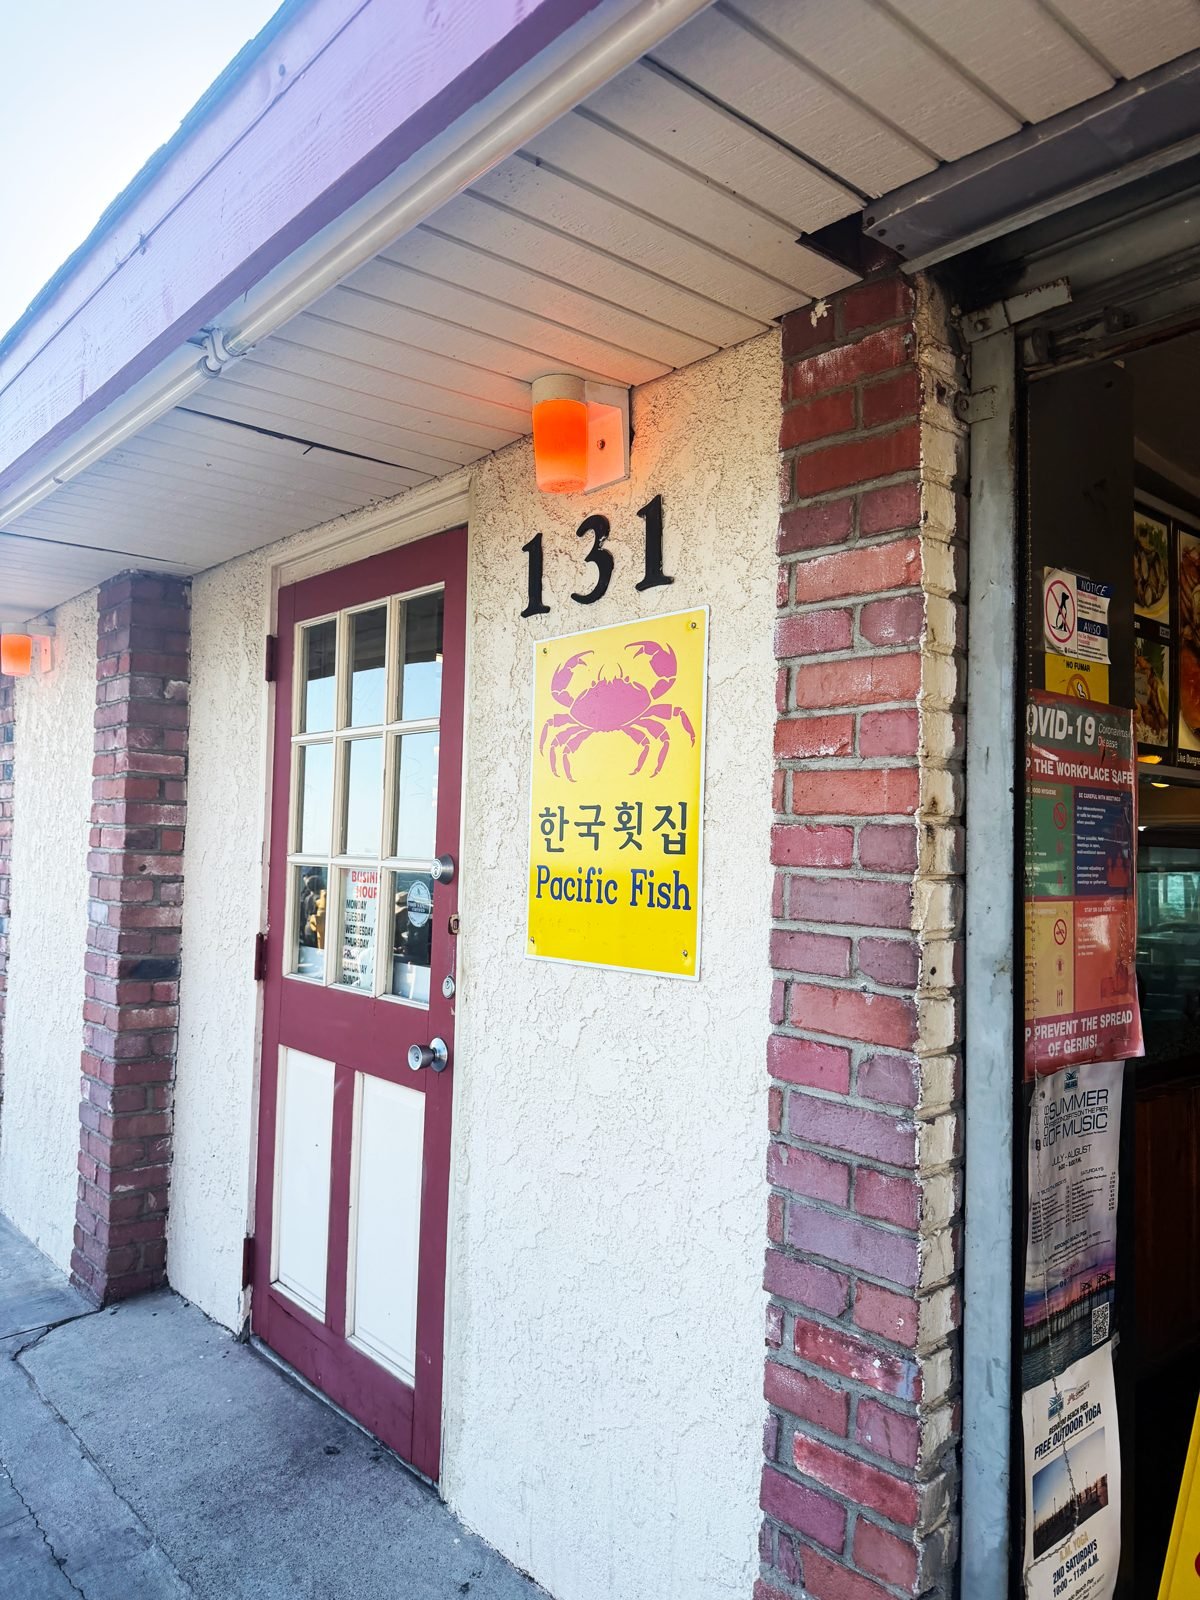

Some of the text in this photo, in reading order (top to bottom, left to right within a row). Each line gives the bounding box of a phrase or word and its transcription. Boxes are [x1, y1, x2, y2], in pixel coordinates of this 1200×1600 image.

[520, 494, 674, 619] 131
[1080, 580, 1108, 596] NOTICE
[1083, 622, 1102, 635] AVISO
[1066, 661, 1090, 673] NO FUMAR
[1026, 703, 1096, 746] OVID-19
[1034, 758, 1054, 775] THE
[1056, 763, 1110, 782] WORKPLACE
[1111, 769, 1134, 785] SAFE
[539, 802, 689, 856] 한국횟집
[352, 871, 377, 883] BUSIN
[535, 864, 692, 911] Pacific Fish
[345, 911, 367, 922] TUESDAY
[346, 899, 367, 910] MONDAY
[345, 924, 374, 937] WEDNESDAY
[345, 937, 370, 949] THURSDAY
[1034, 1019, 1079, 1041] PREVENT
[1081, 1016, 1098, 1032] THE
[1100, 1010, 1133, 1029] SPREAD
[1048, 1033, 1098, 1057] OF GERMS!
[1049, 1088, 1109, 1120] SUMMER
[1048, 1113, 1108, 1146] OF MUSIC
[1067, 1407, 1080, 1423] BEACH
[1080, 1401, 1089, 1413] PIER
[1034, 1436, 1051, 1459] FREE
[1052, 1414, 1084, 1445] OUTDOOR
[1084, 1402, 1101, 1424] YOGA
[1053, 1539, 1097, 1585] 2ND SATURDAYS
[1053, 1578, 1068, 1597] 10:00
[1073, 1561, 1087, 1581] 11:00
